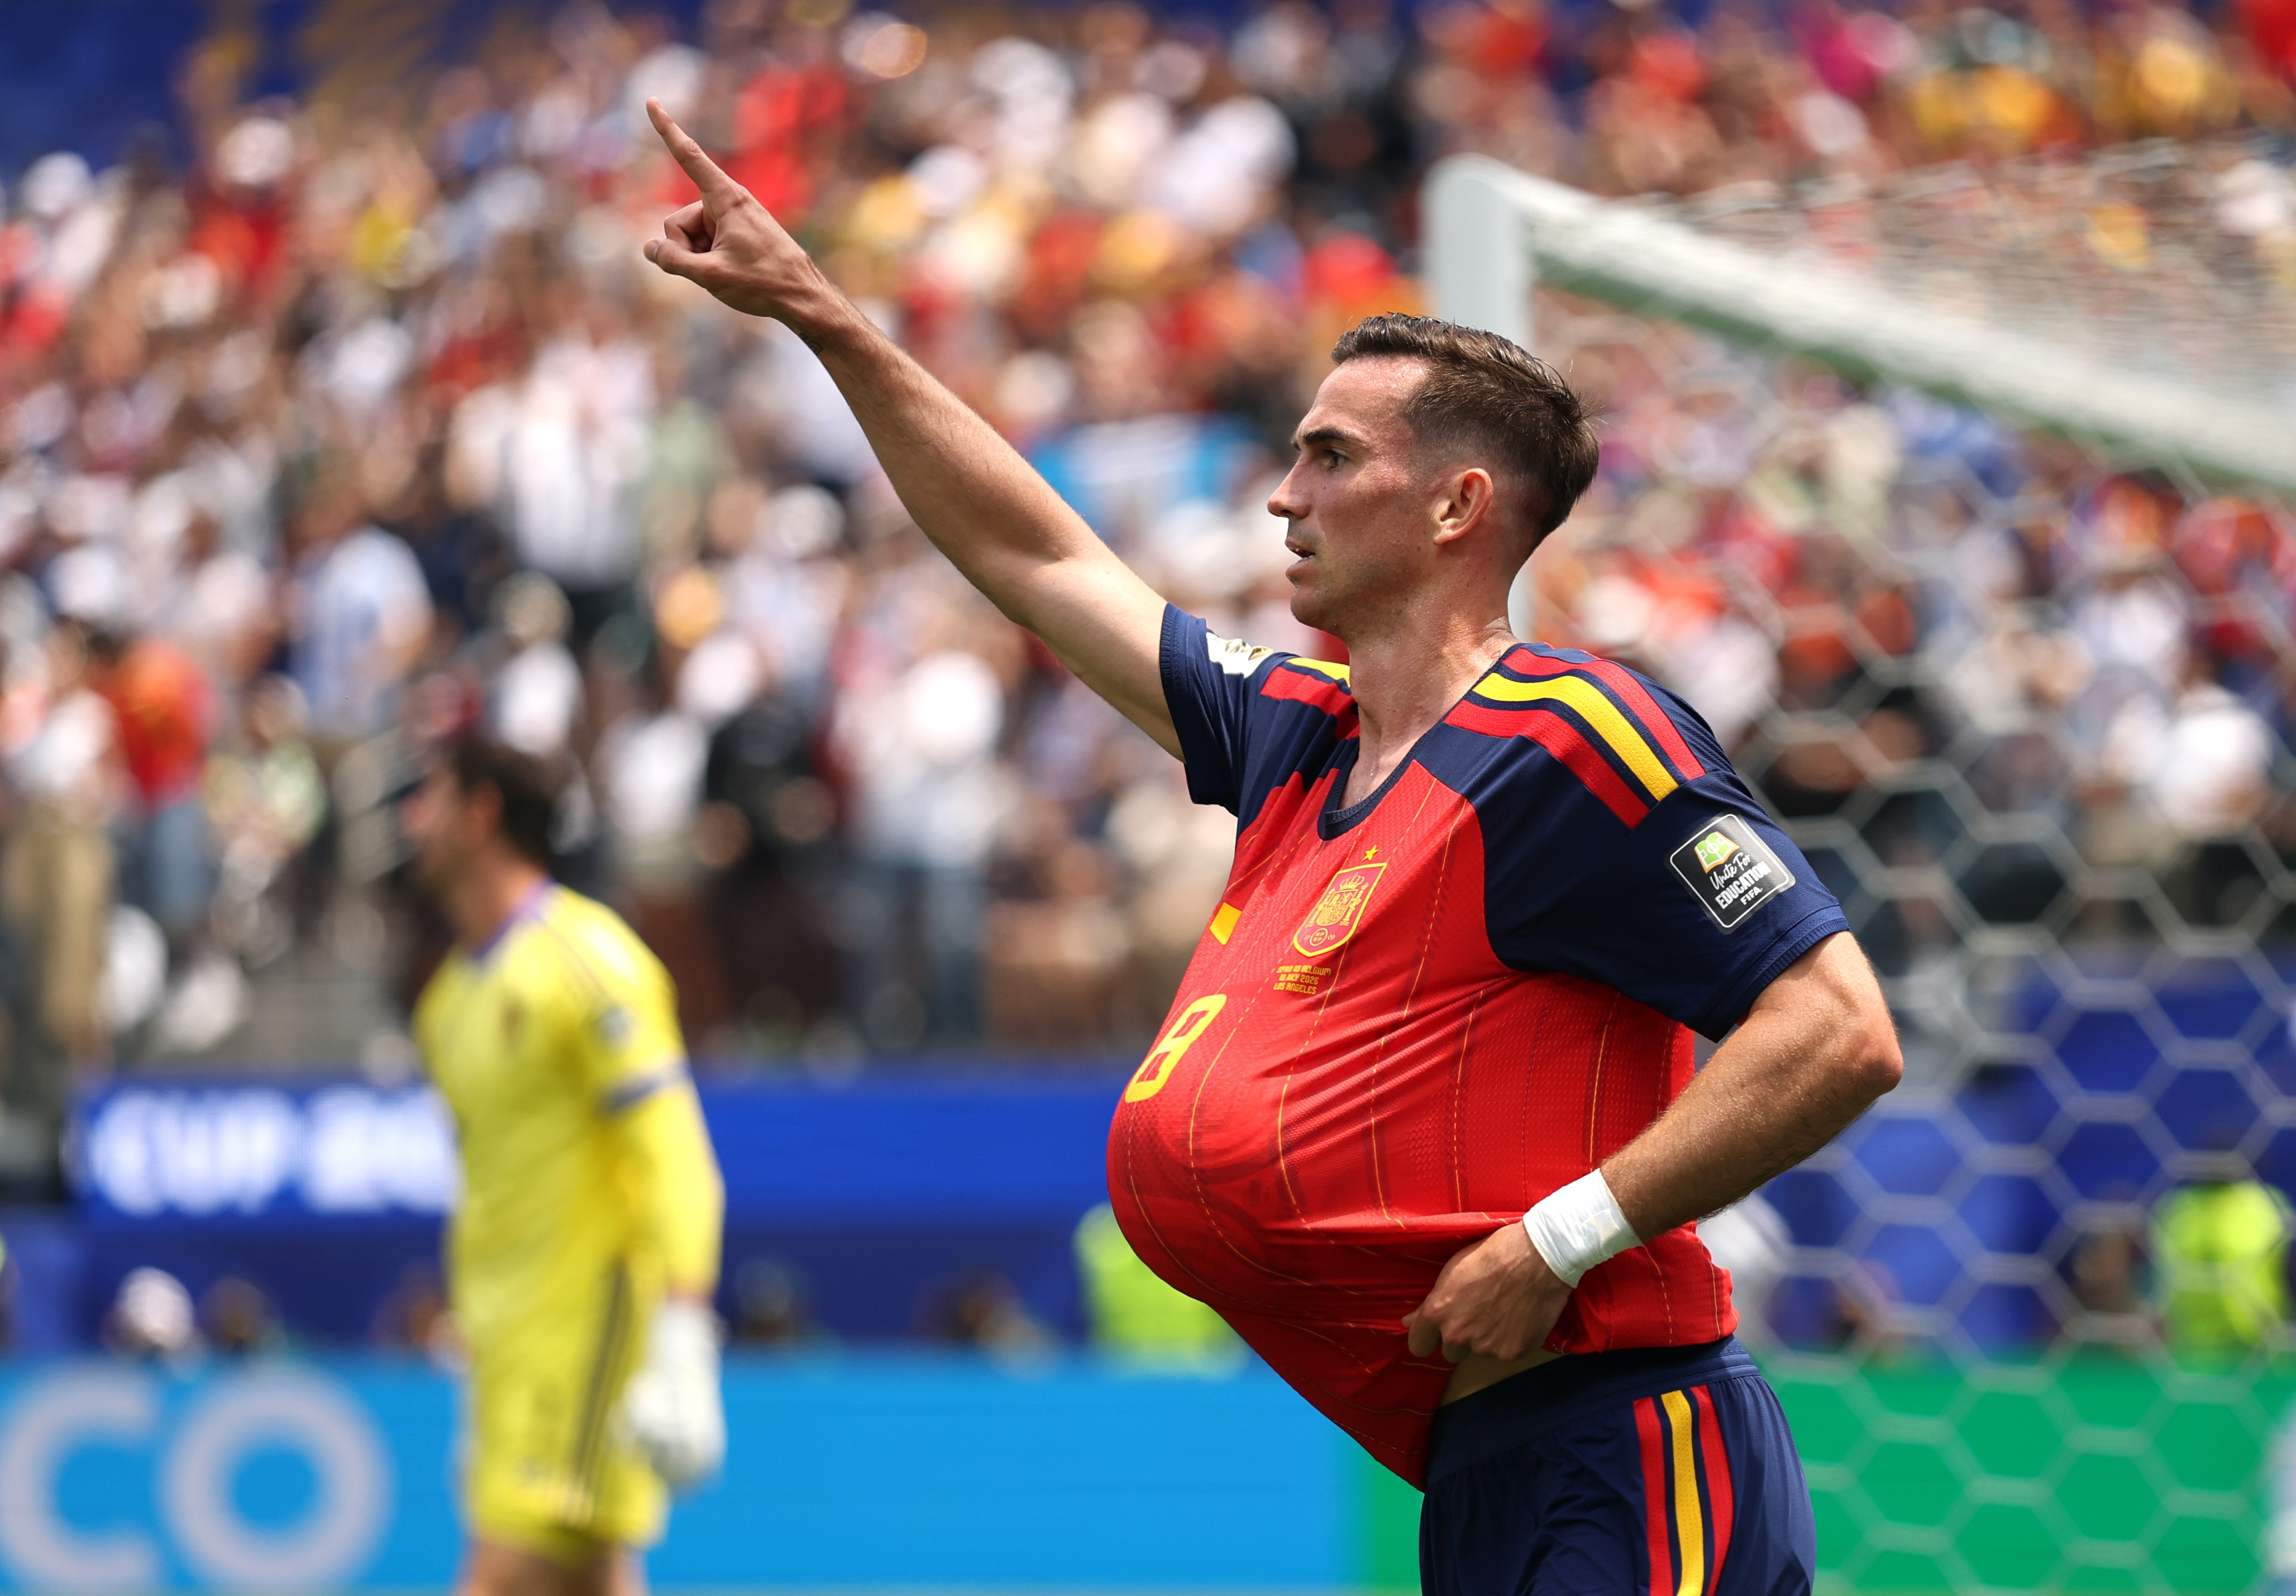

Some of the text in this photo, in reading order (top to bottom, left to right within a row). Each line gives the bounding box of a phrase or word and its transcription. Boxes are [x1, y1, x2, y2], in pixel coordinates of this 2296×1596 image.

[1710, 852, 1751, 890] Unite For
[1715, 861, 1772, 909] EDUCATION
[1740, 887, 1762, 905] FIFA
[1300, 974, 1319, 985] 2026
[1301, 965, 1331, 976] BELGIUM
[1286, 982, 1317, 995] ANGELES
[1125, 993, 1227, 1103] 8
